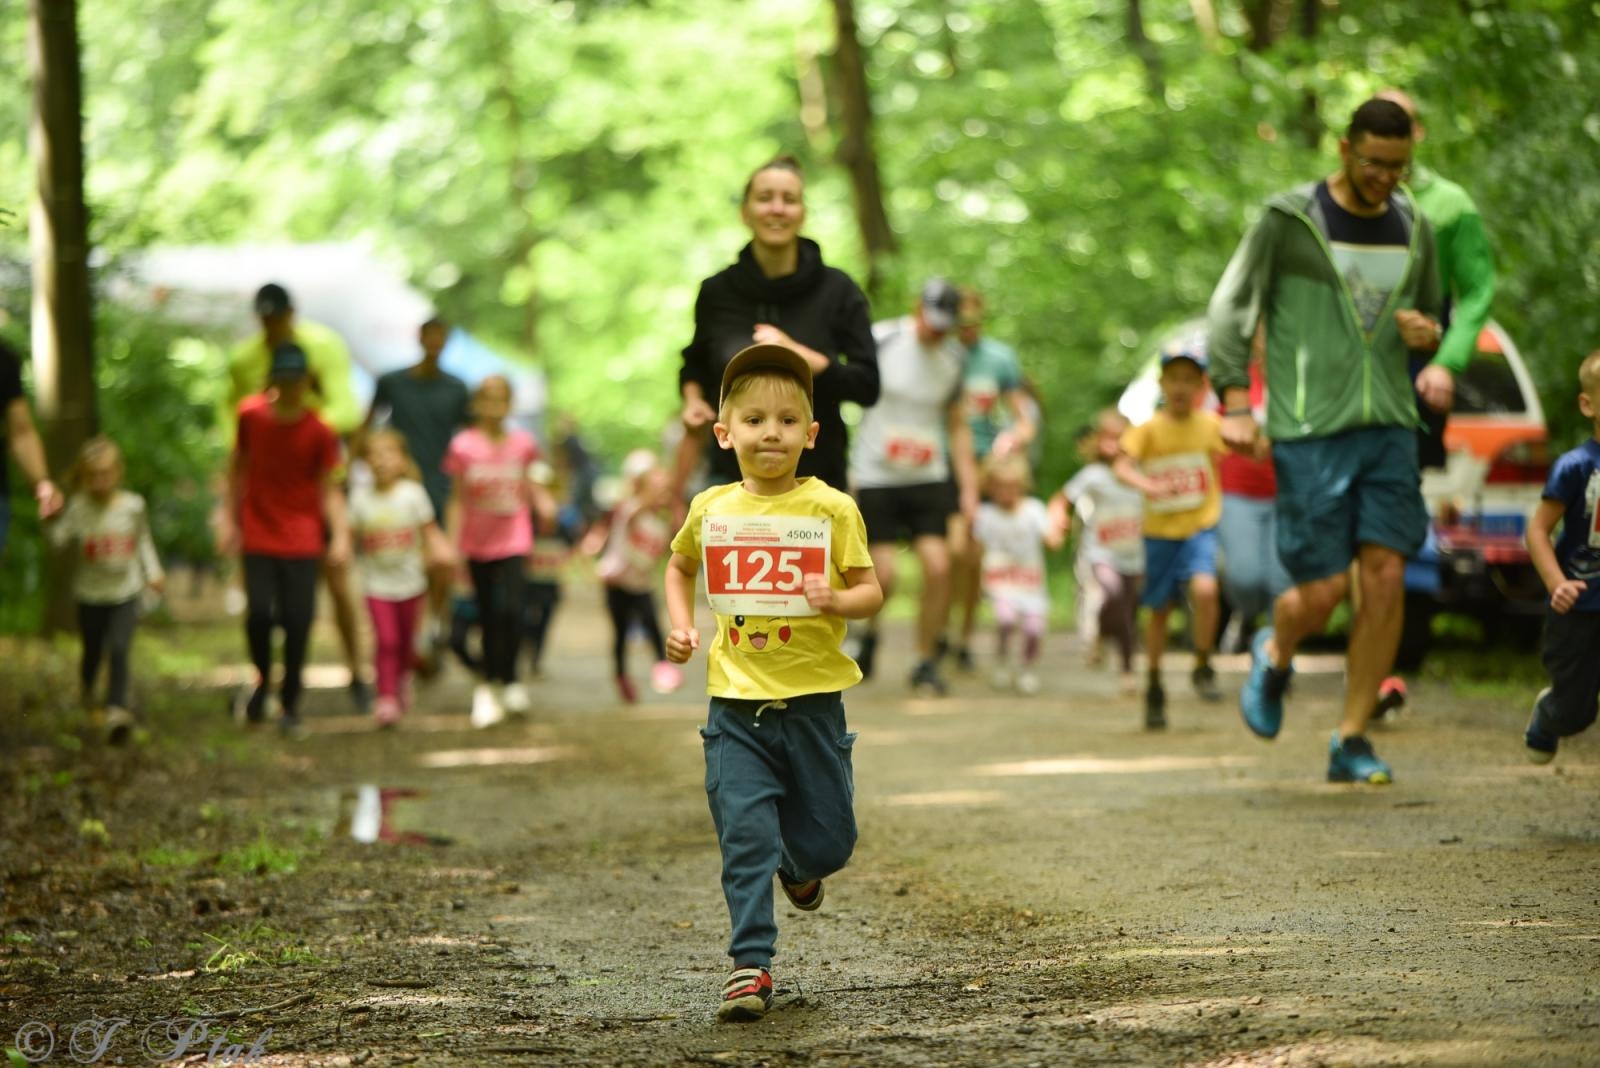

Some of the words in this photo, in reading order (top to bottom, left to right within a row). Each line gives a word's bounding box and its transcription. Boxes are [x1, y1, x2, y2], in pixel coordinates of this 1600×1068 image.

[710, 523, 728, 534] Bieg
[787, 530, 812, 540] 4500
[814, 531, 824, 540] M
[722, 550, 803, 592] 125
